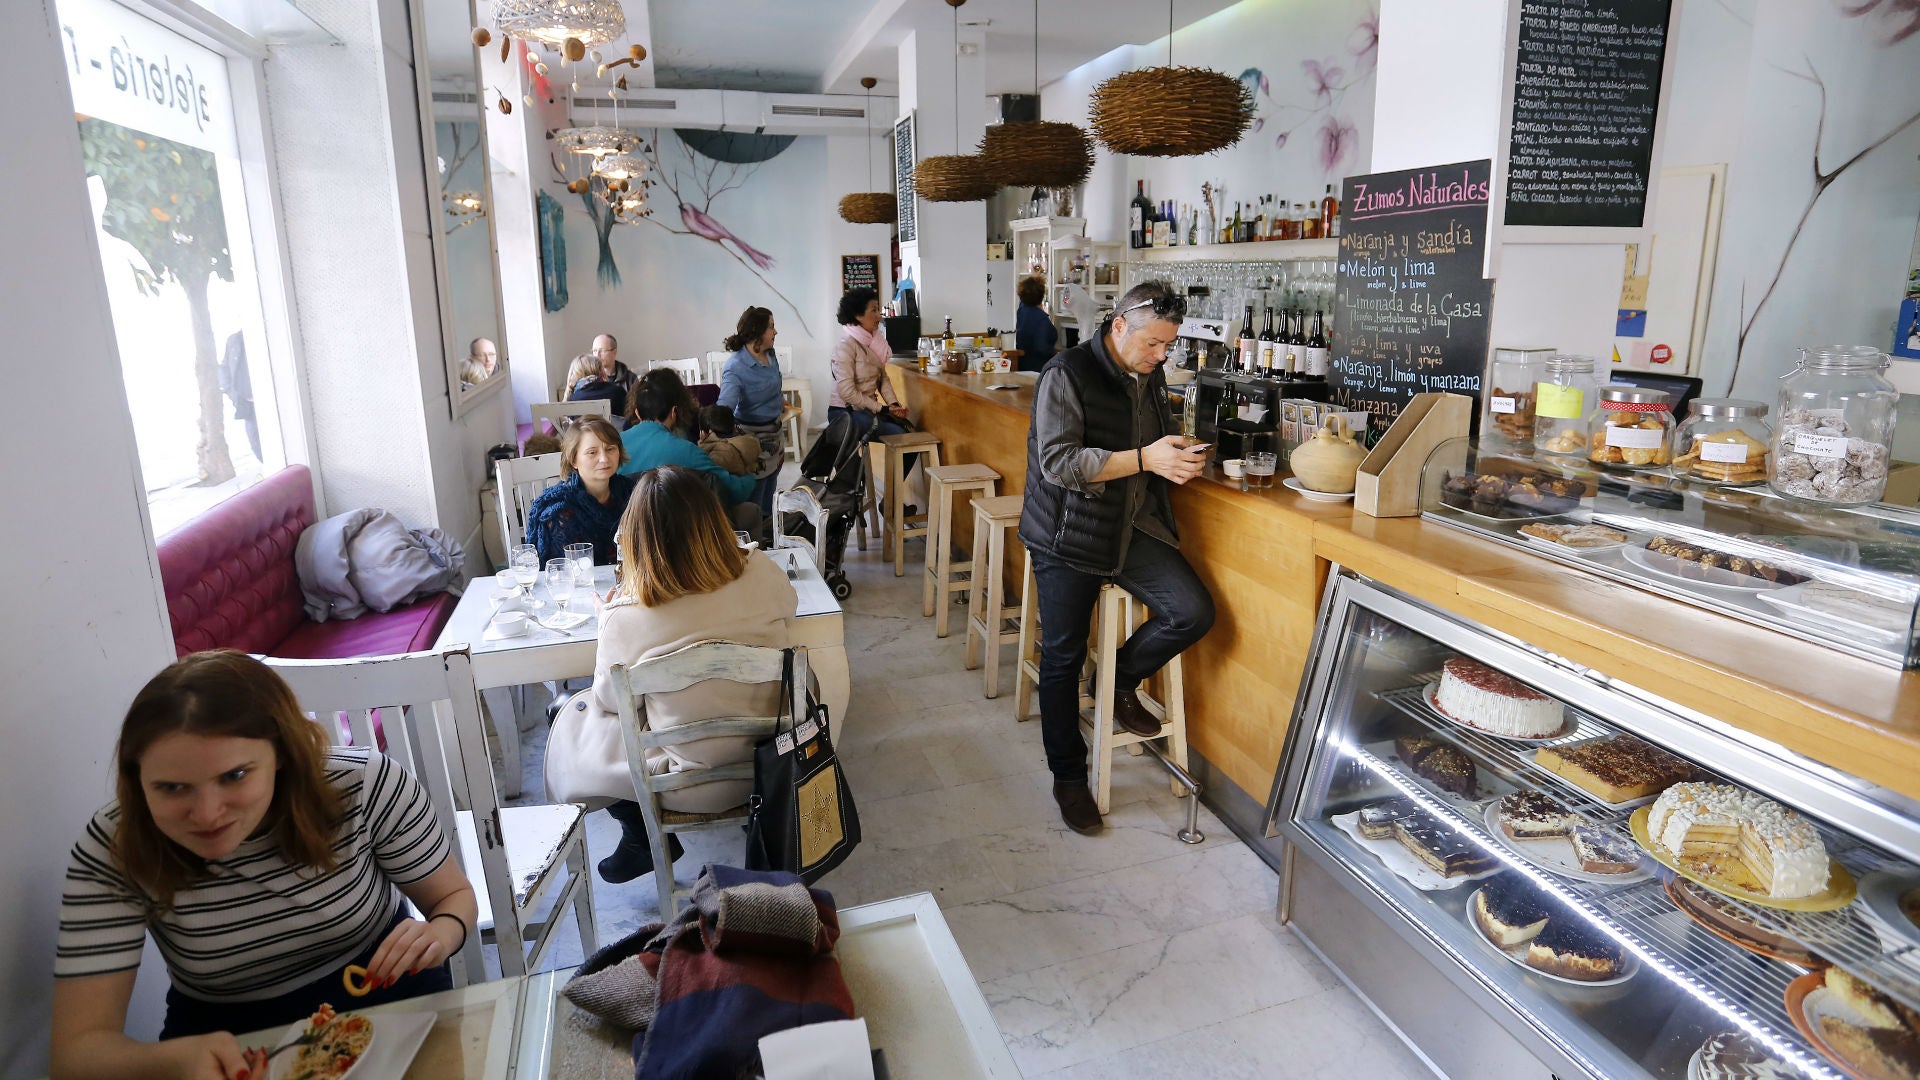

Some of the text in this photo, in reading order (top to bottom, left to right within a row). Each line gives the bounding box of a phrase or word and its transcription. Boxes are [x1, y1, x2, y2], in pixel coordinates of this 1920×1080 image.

[1353, 170, 1490, 212] Zumos Naturales
[1347, 219, 1473, 260] Naranja y Sandía
[1346, 258, 1436, 292] Melón y lima
[1409, 279, 1427, 289] lime
[1346, 288, 1482, 317] Limonada de la Casa
[1375, 334, 1398, 351] lima
[1405, 343, 1411, 364] y
[1420, 345, 1441, 355] uva
[1418, 356, 1443, 370] grapes
[1391, 359, 1416, 383] limón
[1420, 374, 1428, 393] y
[1431, 374, 1480, 390] manzana
[1337, 387, 1399, 417] Manzana
